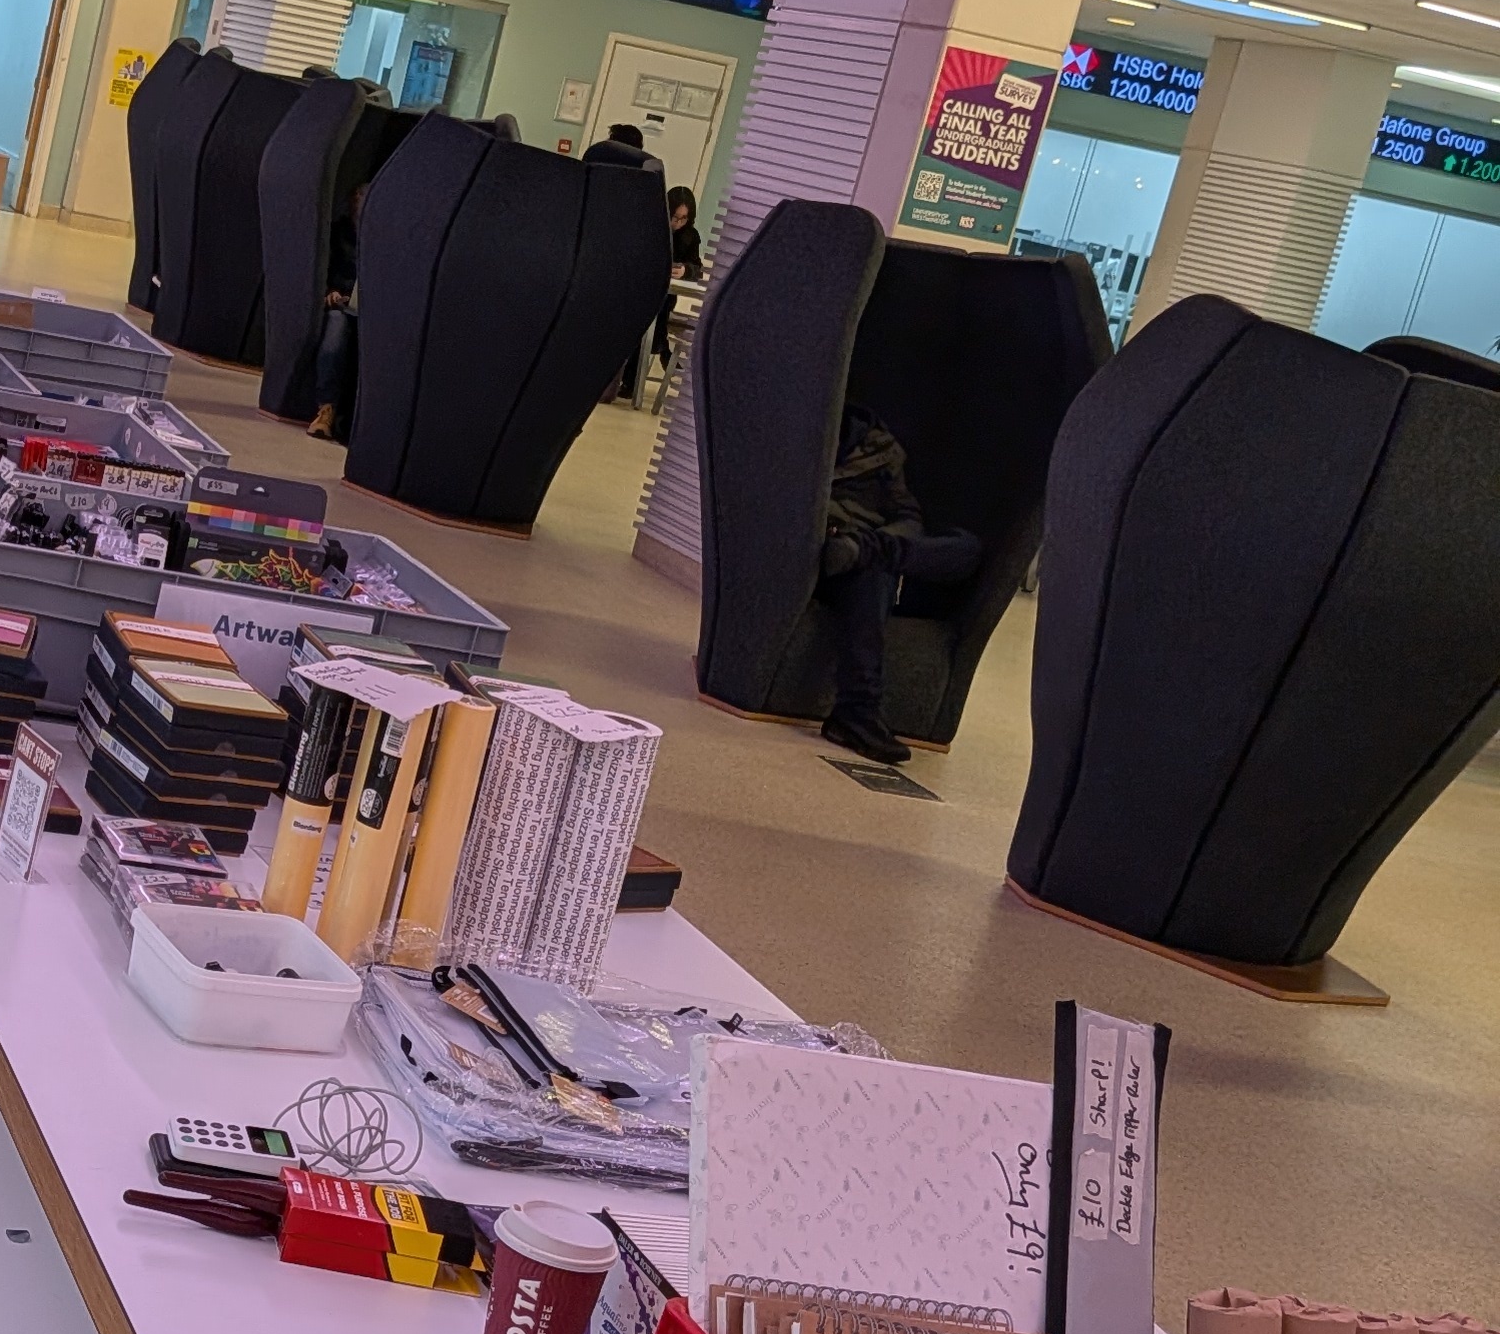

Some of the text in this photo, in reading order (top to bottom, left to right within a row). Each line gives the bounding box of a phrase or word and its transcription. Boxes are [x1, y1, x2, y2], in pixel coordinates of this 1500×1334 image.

[1061, 71, 1095, 91] SBC
[1113, 54, 1168, 81] HSBC
[943, 99, 1032, 129] CALLING ALL
[999, 86, 1036, 105] SURVEY
[1110, 78, 1197, 114] 1200.4000
[936, 128, 1024, 155] UNDERGRADUATE
[939, 113, 1028, 144] FINAL YEAR
[1436, 127, 1486, 157] Group
[931, 138, 1020, 171] STUDENTS
[121, 622, 171, 634] DOODLE
[212, 614, 294, 647] Artwa
[33, 747, 57, 776] STOP?
[304, 726, 317, 754] TRACING
[515, 715, 539, 767] sspapper
[530, 720, 553, 763] etching
[480, 738, 509, 817] luonnospaperi
[501, 767, 526, 821] sketching
[523, 763, 540, 796] paper
[531, 737, 562, 815] Skizzenpapier
[593, 746, 624, 826] Skizzenpapier
[608, 766, 633, 827] Tervakoski
[466, 709, 528, 913] ospaperi skisspapper sketching paper
[565, 775, 588, 829] sketching
[464, 817, 489, 883] skisspapper
[493, 822, 511, 855] paper
[502, 797, 533, 875] Skizzenpapier
[506, 757, 566, 957] Tervakoski luonnospaperi skisspapp
[517, 815, 542, 876] Tervakoski
[549, 740, 611, 945] ching paper Skizzenpapier Tervakoski
[556, 830, 572, 863] paper
[578, 826, 604, 887] Tervakoski
[583, 735, 651, 964] koski luonnospaperi skisspapper sketching
[586, 827, 616, 905] luonnospaperi
[449, 883, 473, 937] sketching
[473, 856, 504, 934] Skizzenpapier
[488, 876, 513, 936] Tervakoski
[537, 864, 566, 941] Skizzenpapier
[1119, 1143, 1140, 1180] Edge
[384, 1190, 396, 1206] THE
[399, 1193, 415, 1221] FIT FOR
[992, 1142, 1046, 1274] Only £9!
[1078, 1178, 1105, 1228] £10
[616, 1232, 662, 1285] DALER ROWNEY
[598, 1295, 628, 1334] Aquafine
